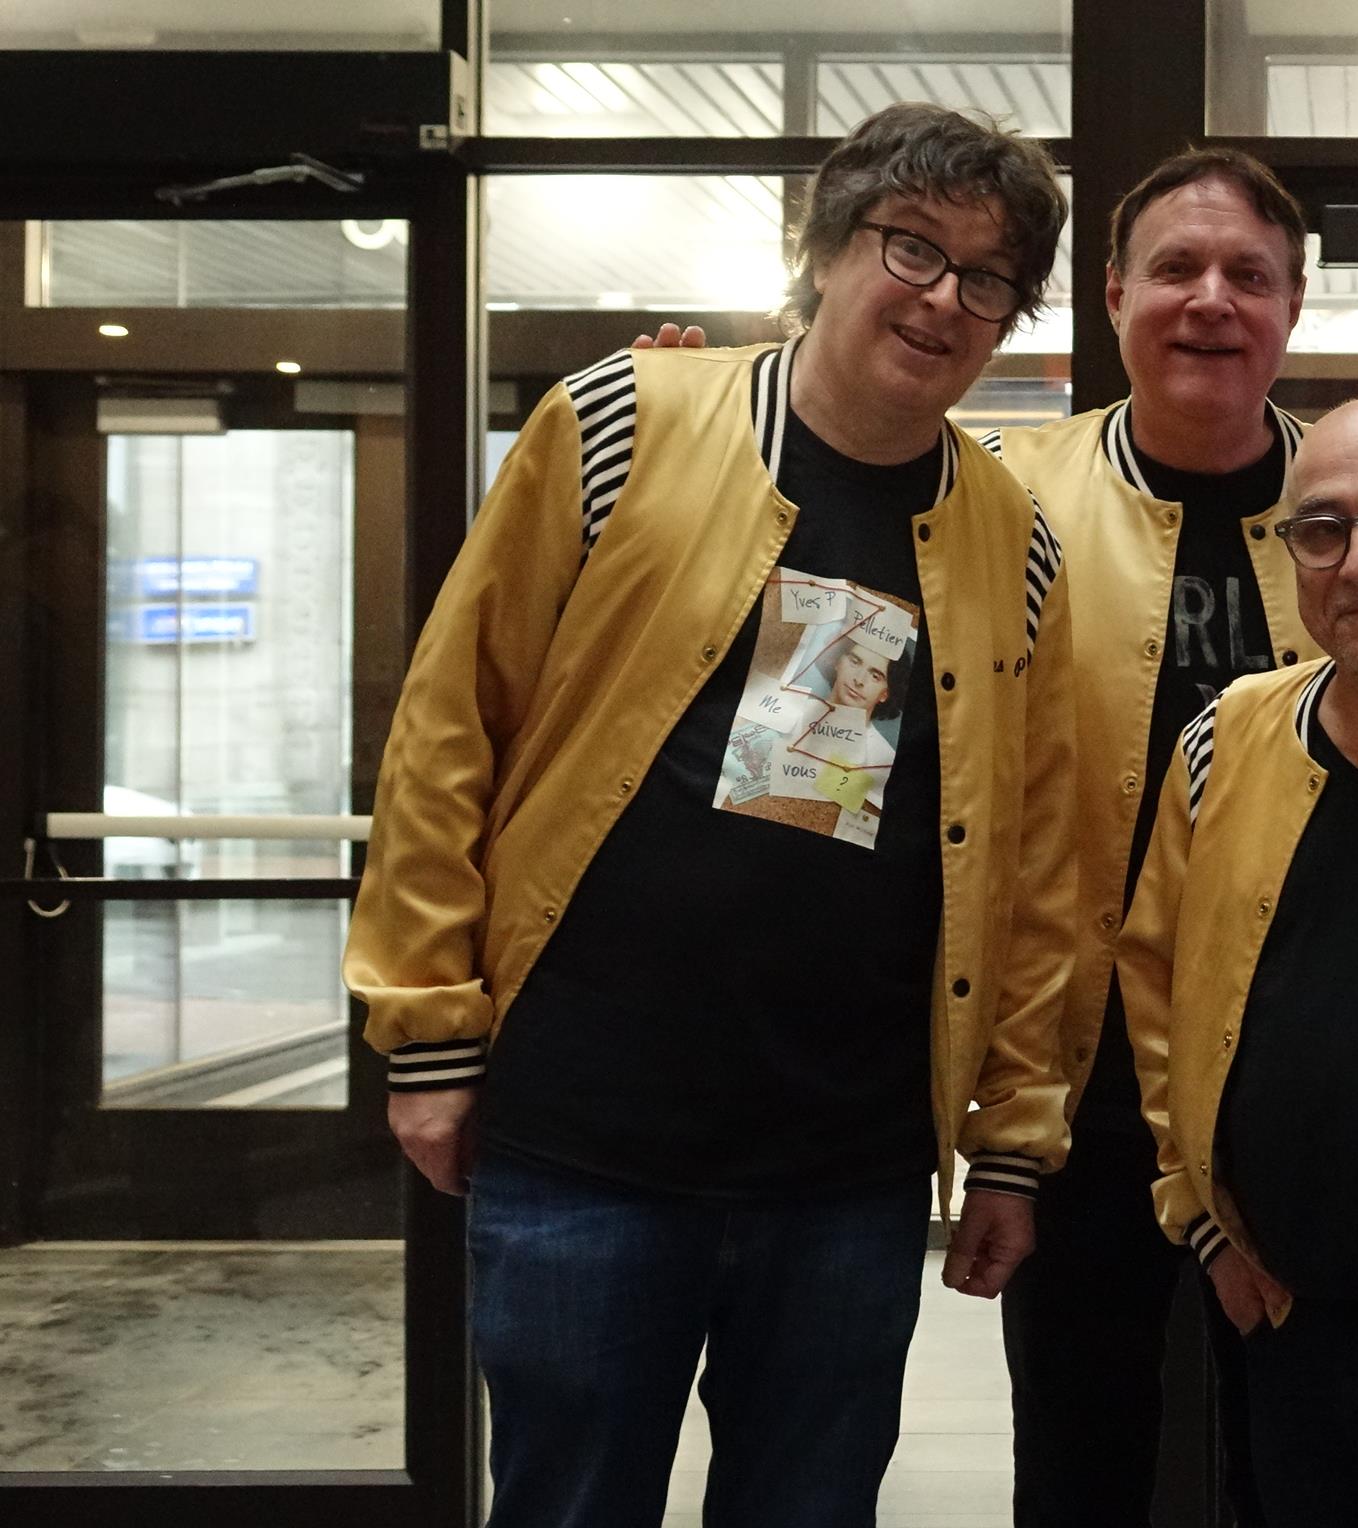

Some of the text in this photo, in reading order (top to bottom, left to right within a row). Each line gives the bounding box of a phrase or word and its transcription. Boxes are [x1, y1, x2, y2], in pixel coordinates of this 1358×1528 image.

[790, 589, 836, 610] Yves P
[853, 610, 904, 646] Pelletier
[758, 695, 782, 714] Me
[782, 764, 817, 779] vous
